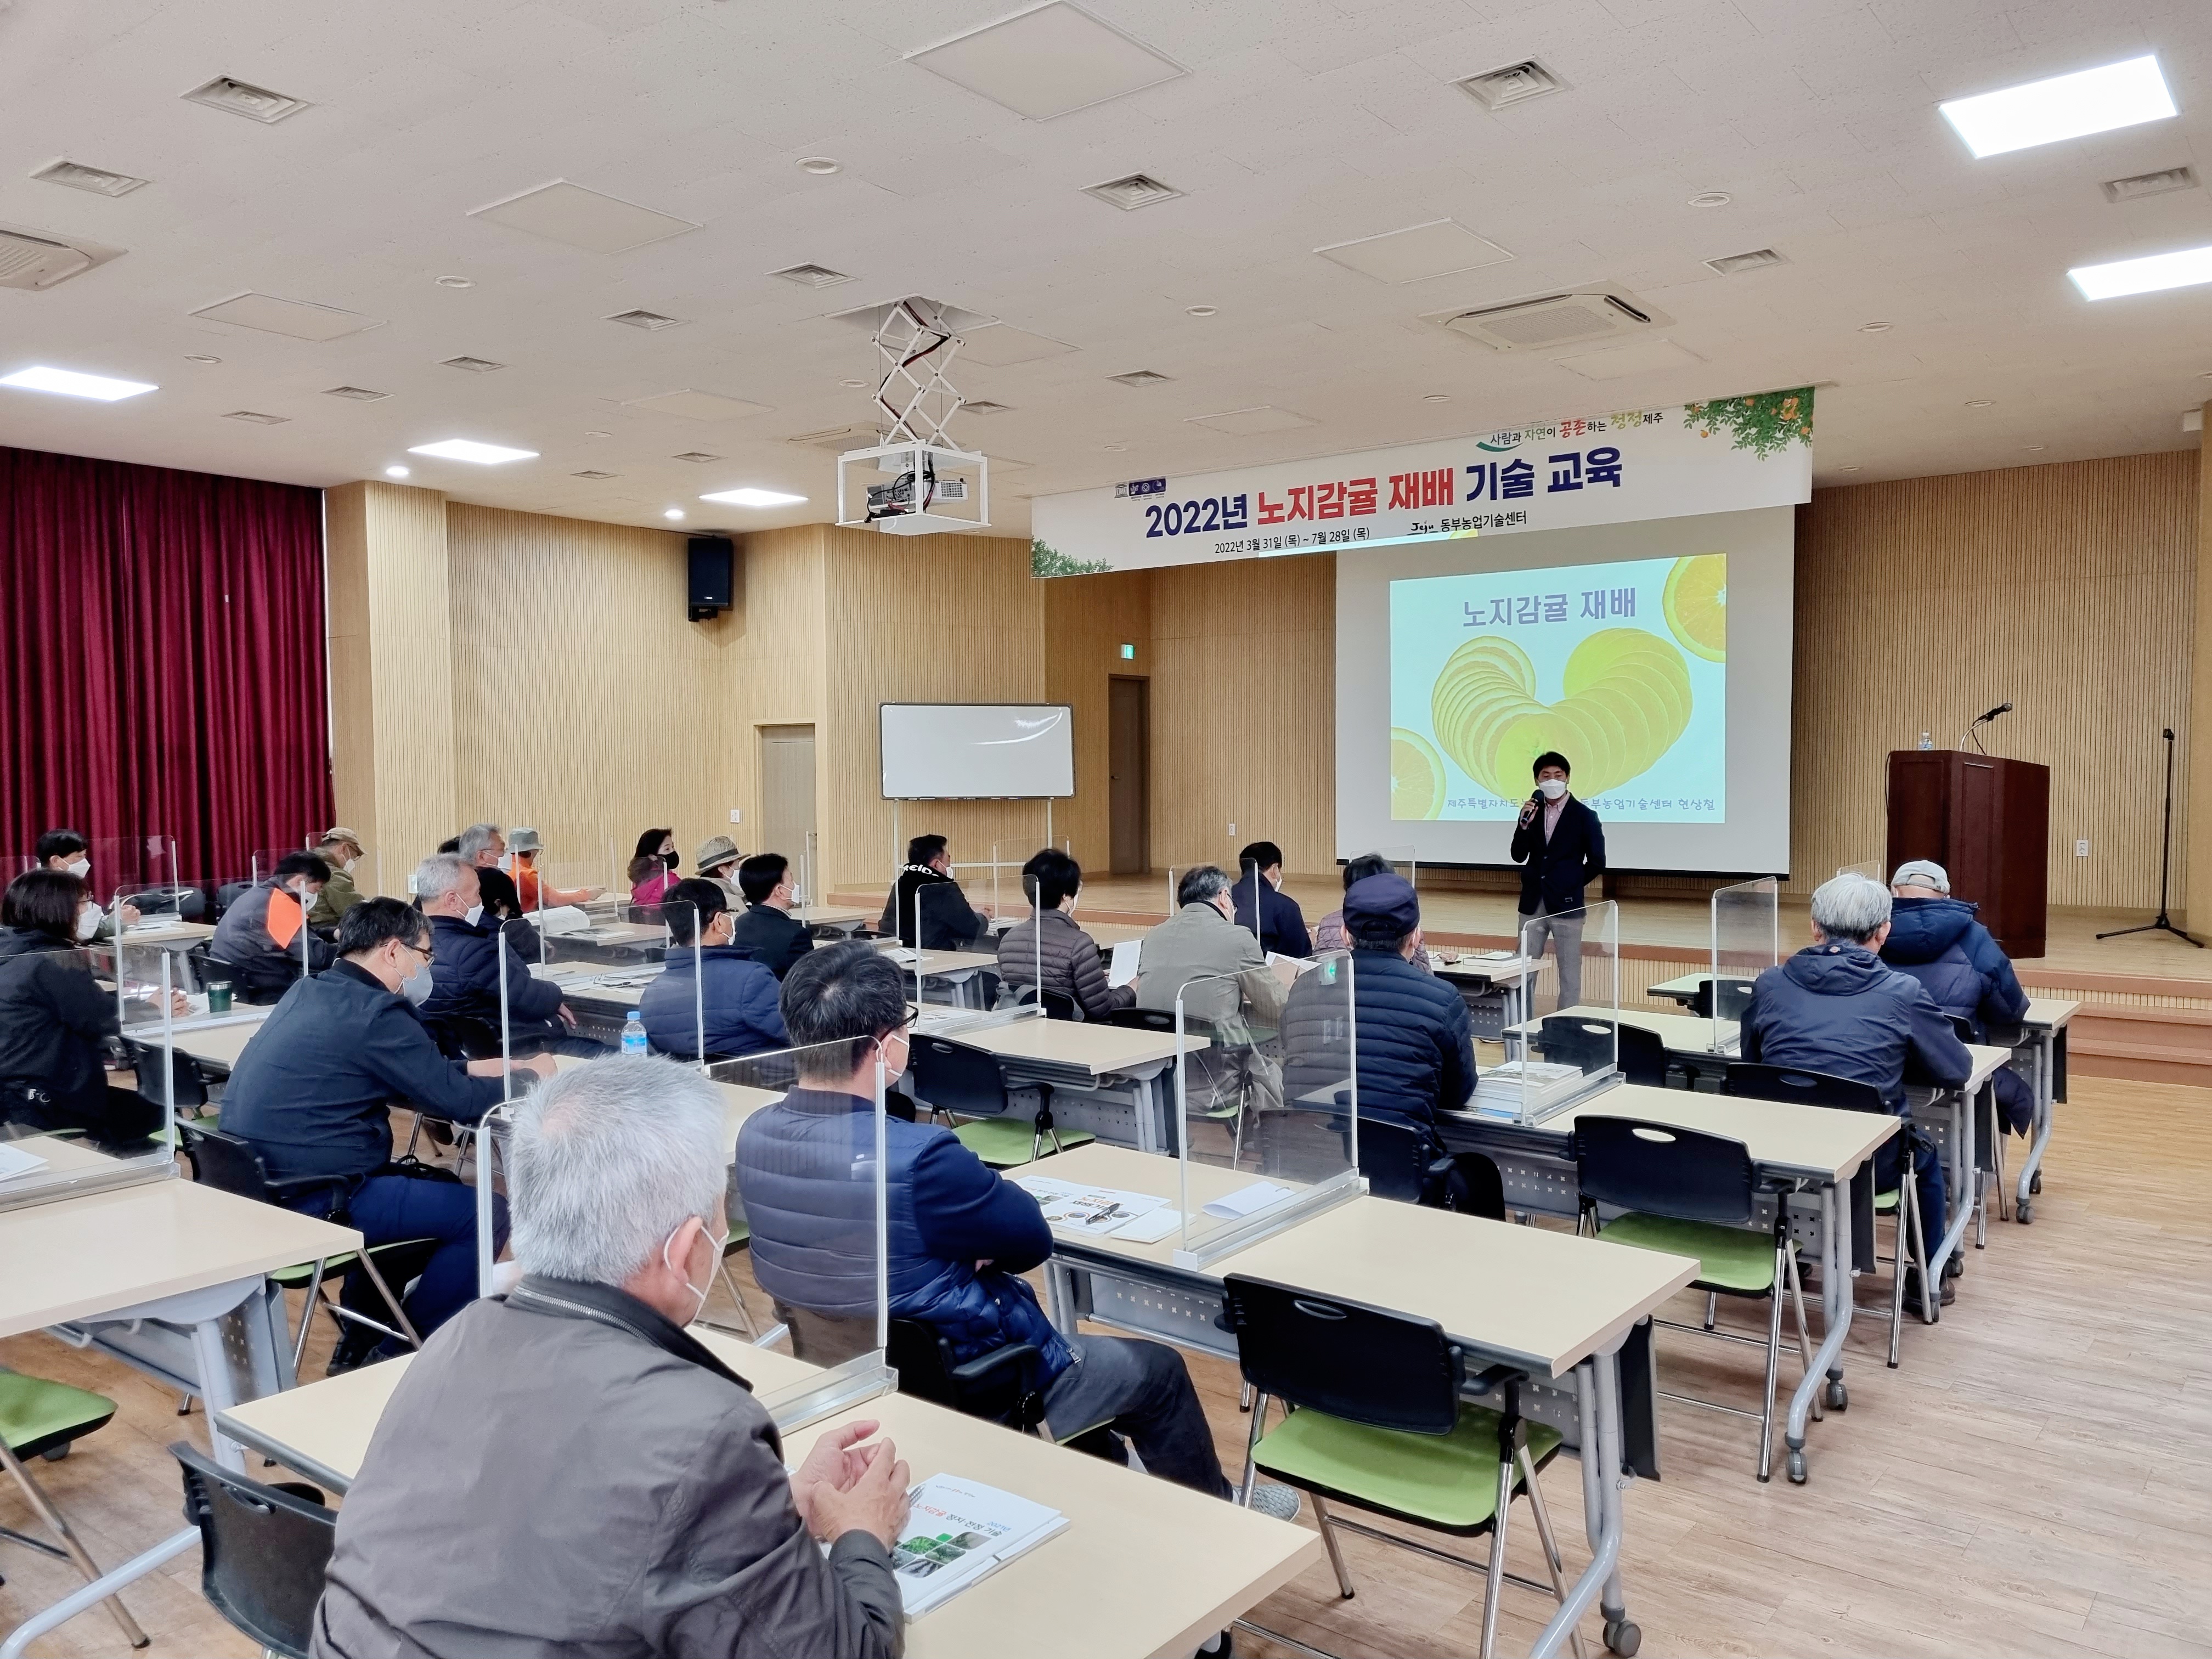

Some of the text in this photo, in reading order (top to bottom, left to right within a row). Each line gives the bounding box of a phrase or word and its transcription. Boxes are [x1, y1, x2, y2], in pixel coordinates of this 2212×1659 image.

[1489, 411, 1664, 446] 사람과 자연이 공존하는 청정제주
[1145, 446, 1622, 538] 2022년 노지감귤 재배 기술 교육
[1410, 510, 1527, 534] Jeju 동부농업기술센터
[1215, 539, 1244, 554] 2022년
[1246, 538, 1260, 551] 3월
[1262, 535, 1282, 549] 31일
[1284, 534, 1300, 548] (목)
[1312, 531, 1327, 544] 7월
[1329, 528, 1350, 543] 28일
[1353, 527, 1370, 540] (목)
[1463, 588, 1635, 627] 노지감귤 재배
[1678, 798, 1716, 811] 현상철
[984, 1527, 1002, 1537] 기술
